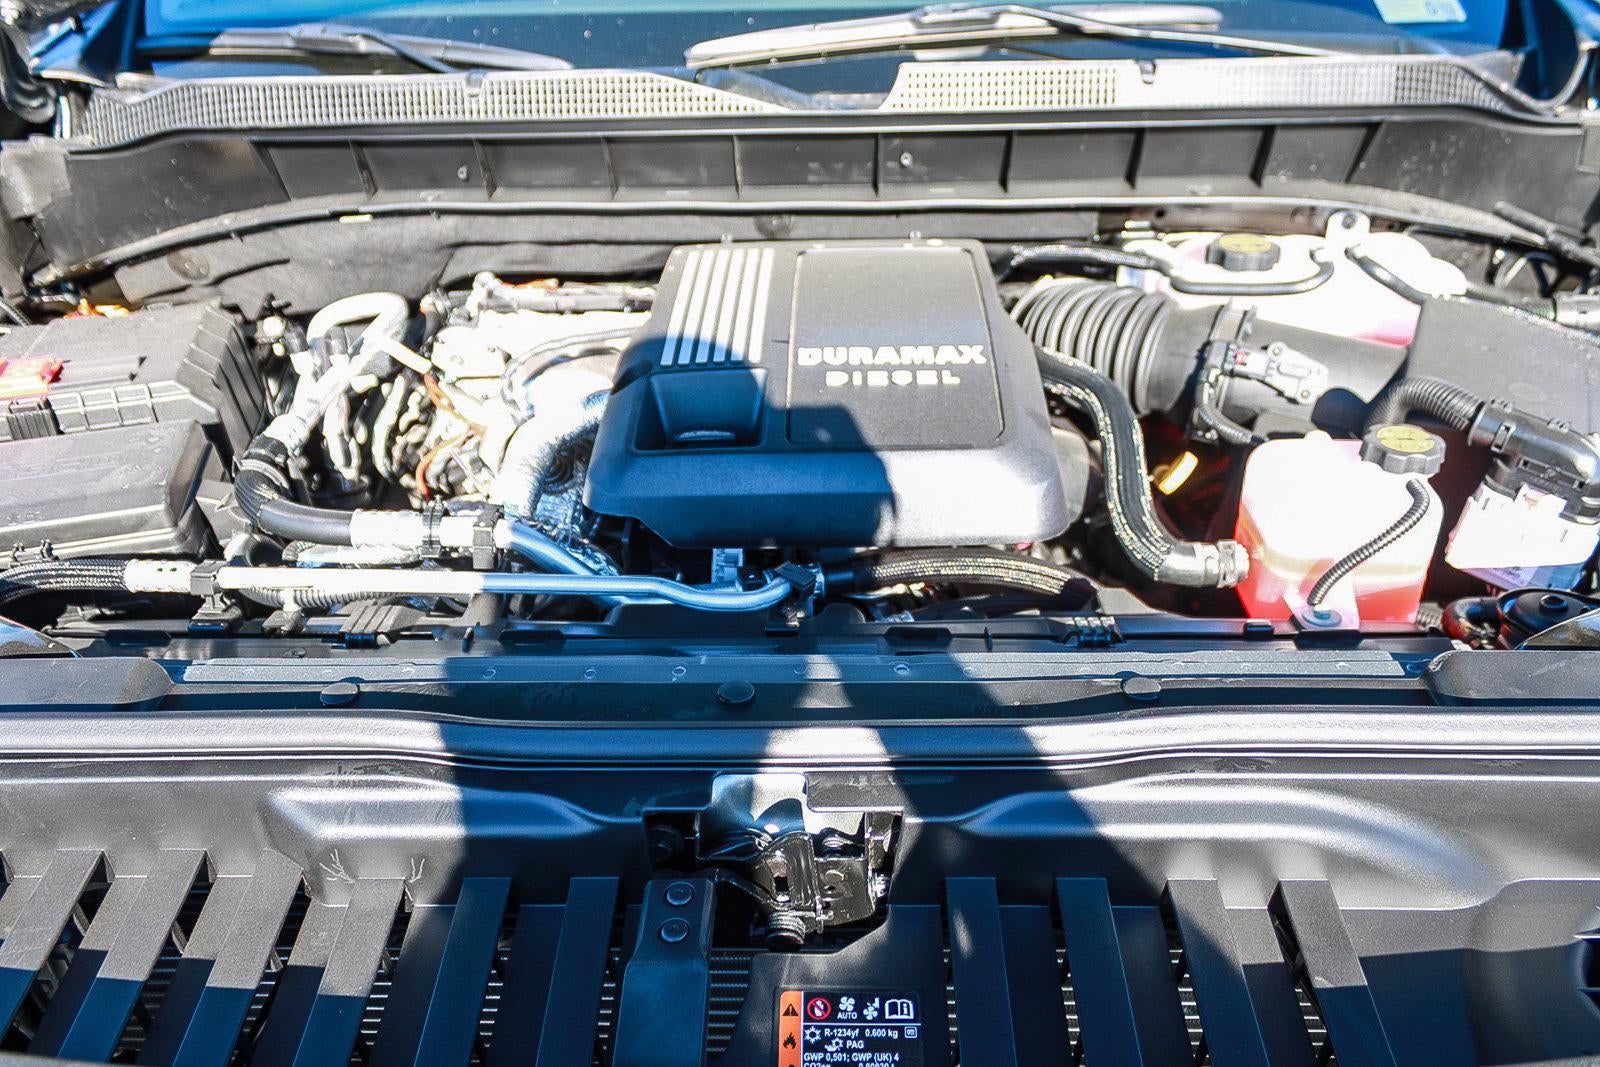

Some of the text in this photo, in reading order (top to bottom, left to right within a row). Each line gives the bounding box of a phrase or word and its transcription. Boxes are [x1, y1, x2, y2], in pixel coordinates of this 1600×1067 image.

[797, 345, 987, 366] DURAMAX
[825, 370, 961, 387] DIESEL
[837, 1011, 858, 1020] AUTO
[824, 1028, 899, 1039] R-1234yf 0.600 kg
[846, 1040, 865, 1049] PAG
[804, 1052, 824, 1061] GWP
[851, 1052, 872, 1061] GWP
[874, 1052, 892, 1063] (UK)
[894, 1053, 899, 1062] 4
